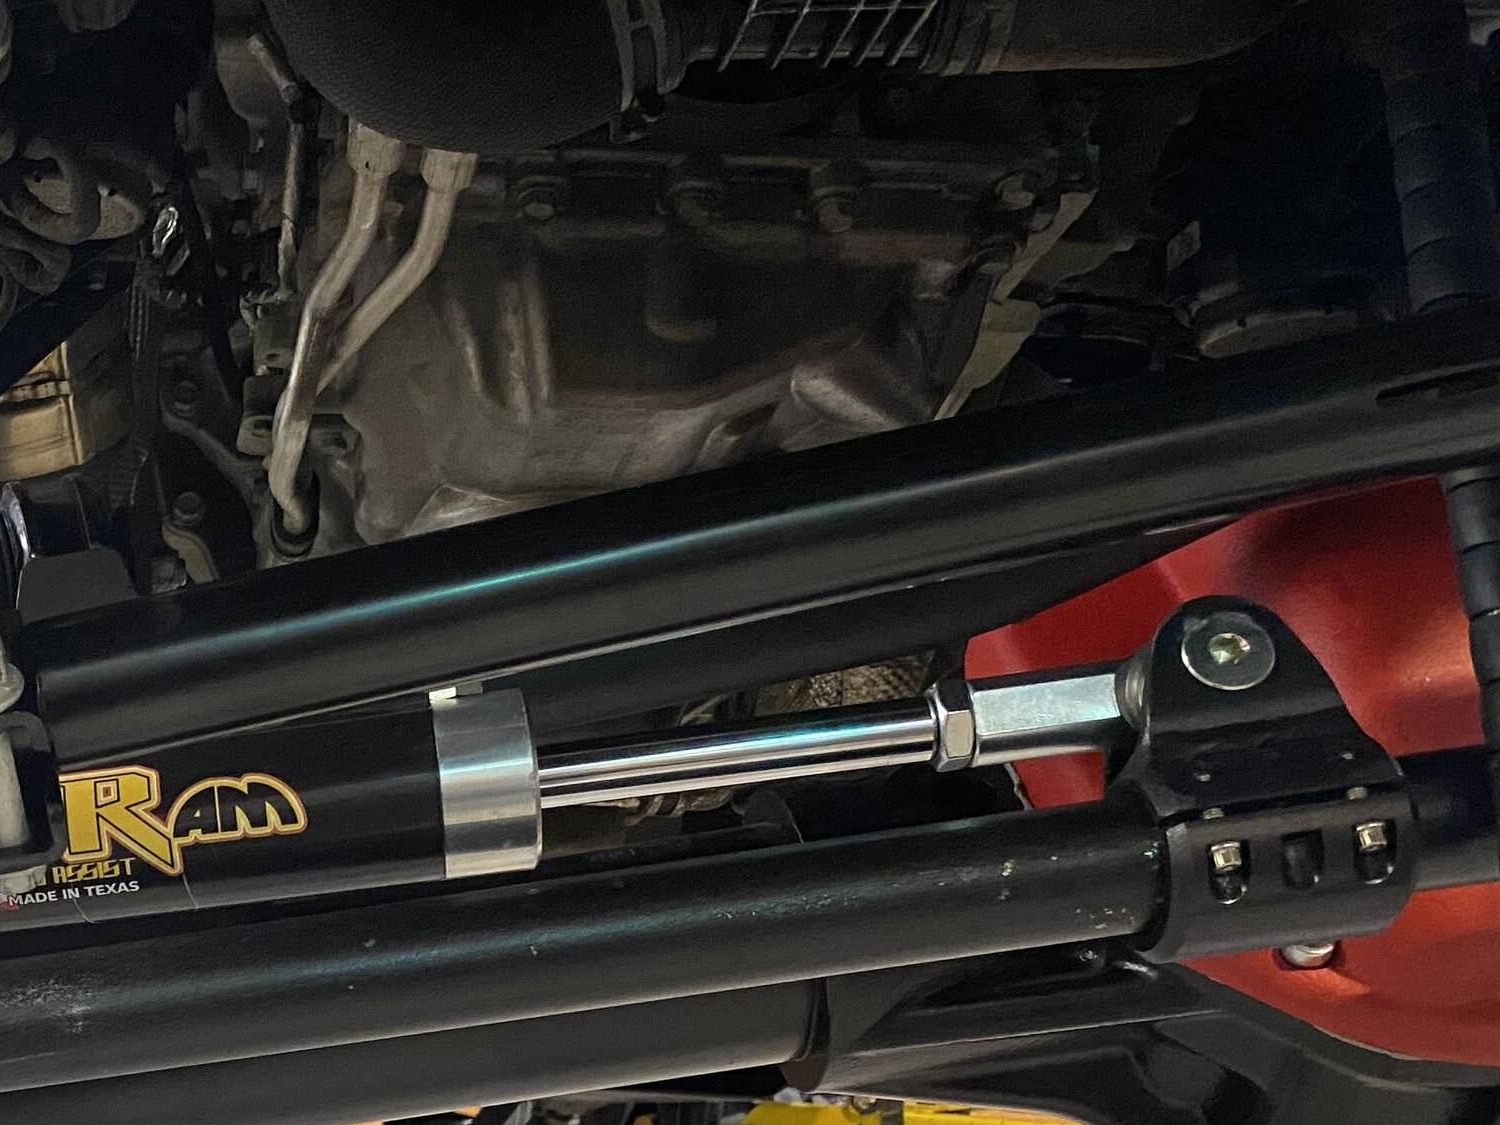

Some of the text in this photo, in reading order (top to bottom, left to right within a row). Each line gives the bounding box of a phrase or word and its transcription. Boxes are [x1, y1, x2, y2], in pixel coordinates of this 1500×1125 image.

[52, 857, 137, 884] ASSIST
[8, 880, 140, 907] MADE IN TEXAS
